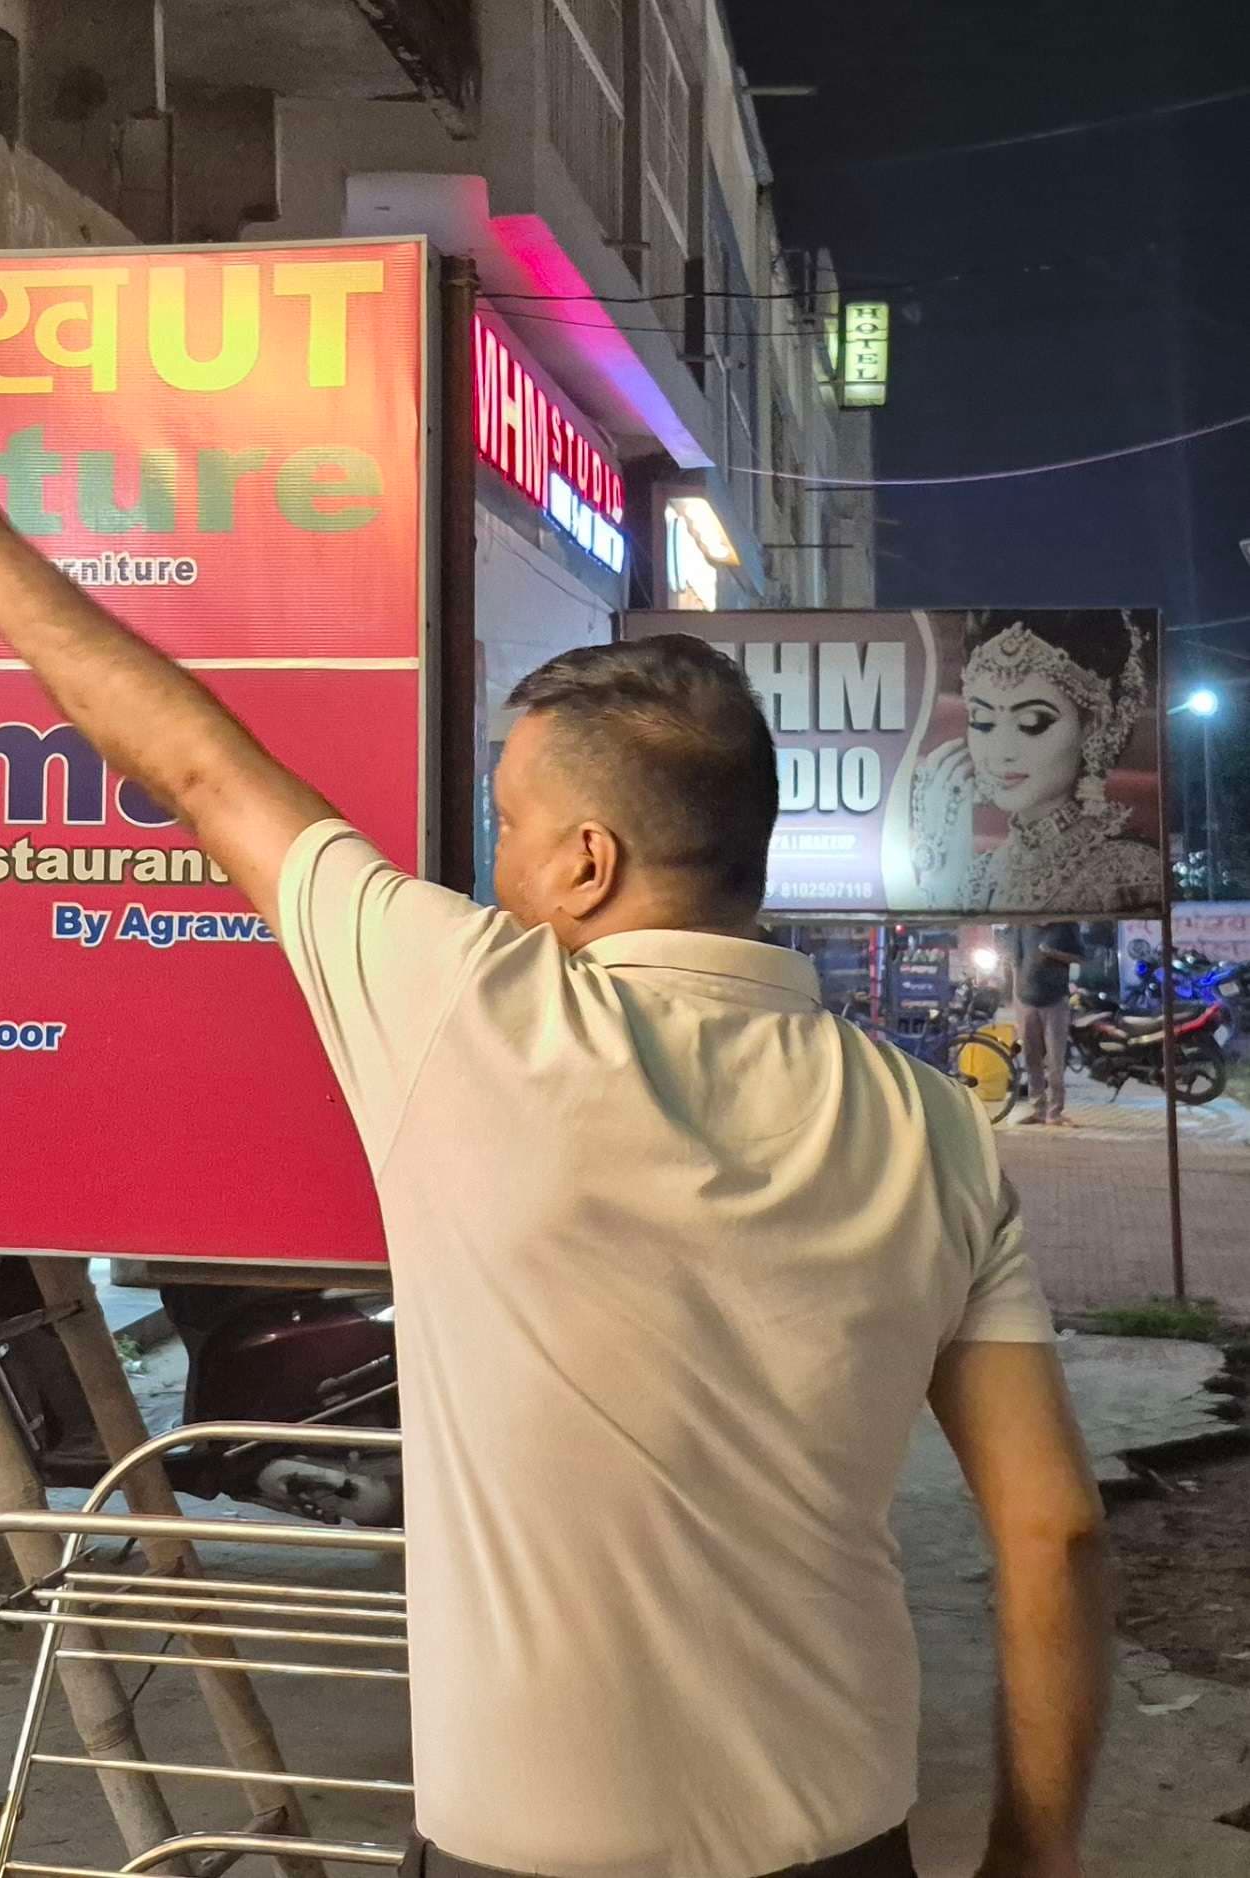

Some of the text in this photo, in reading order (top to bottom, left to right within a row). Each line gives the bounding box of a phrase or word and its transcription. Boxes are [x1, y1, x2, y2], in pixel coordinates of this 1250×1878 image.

[854, 307, 879, 380] HOTEL
[550, 403, 625, 528] STUDIO
[51, 551, 197, 586] rniture
[710, 642, 906, 731] HM
[776, 747, 881, 812] DIO
[52, 903, 111, 948] By
